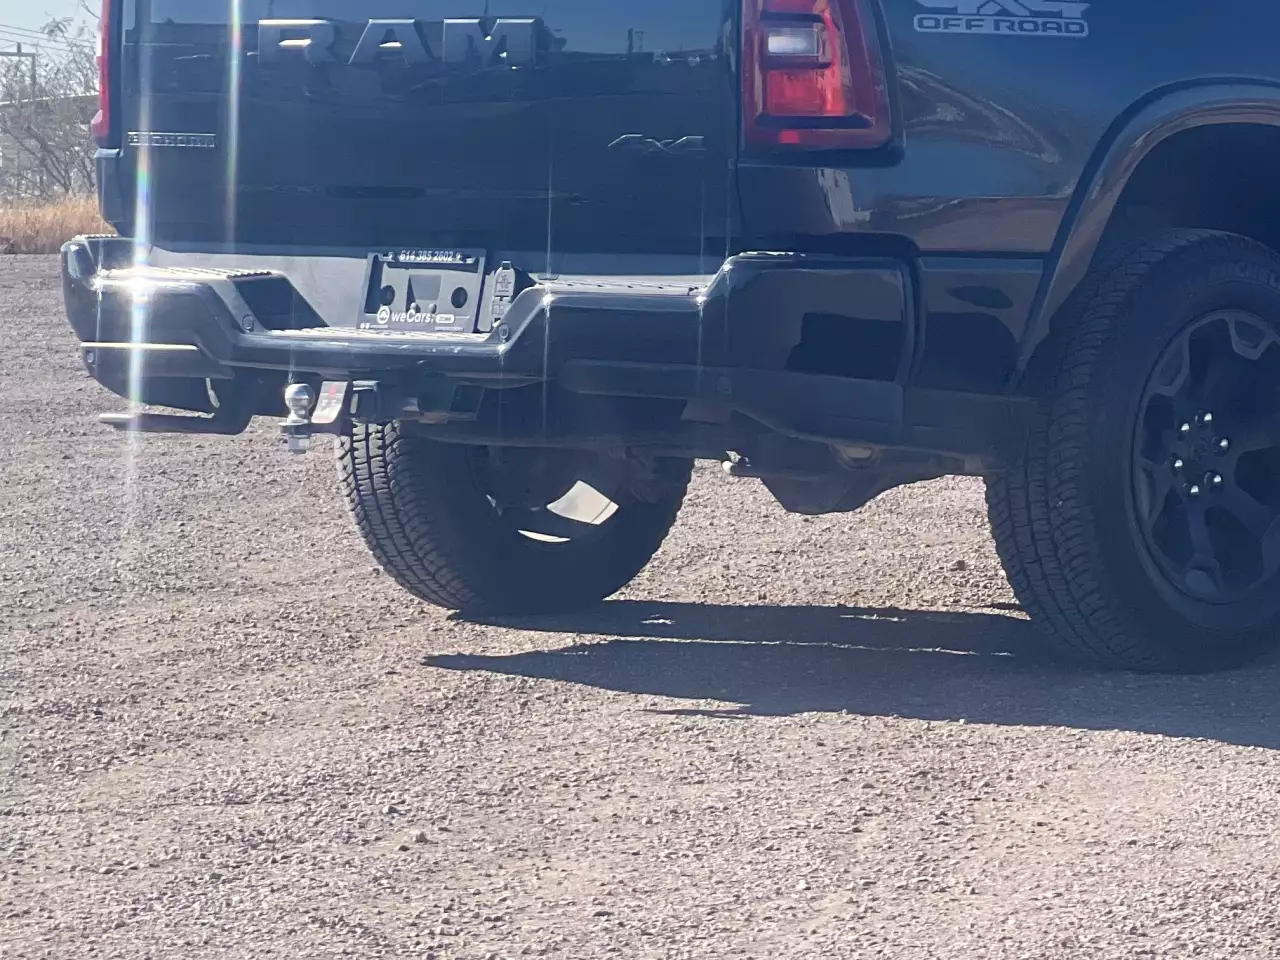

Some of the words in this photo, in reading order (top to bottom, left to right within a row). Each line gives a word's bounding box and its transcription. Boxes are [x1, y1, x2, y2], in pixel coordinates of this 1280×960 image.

[917, 16, 985, 30] OFF
[993, 18, 1086, 34] ROAD
[258, 18, 538, 67] RAM
